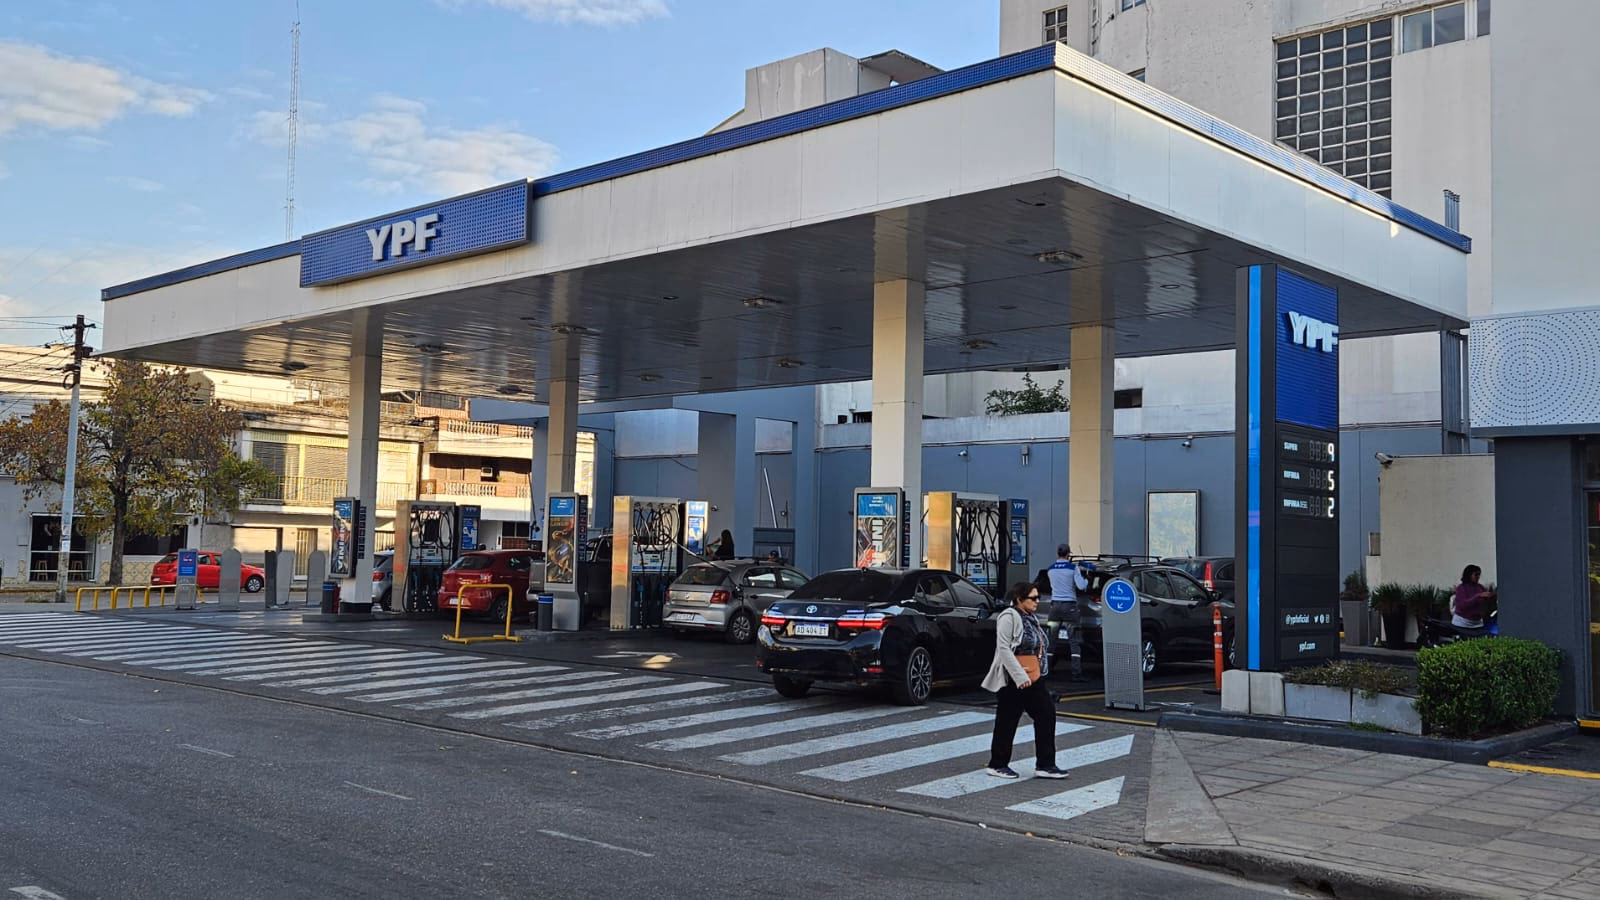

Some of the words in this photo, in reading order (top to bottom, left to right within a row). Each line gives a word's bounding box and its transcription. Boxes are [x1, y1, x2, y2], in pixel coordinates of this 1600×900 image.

[366, 213, 439, 260] YPF
[1289, 311, 1339, 352] YPF
[1013, 502, 1026, 510] YPF
